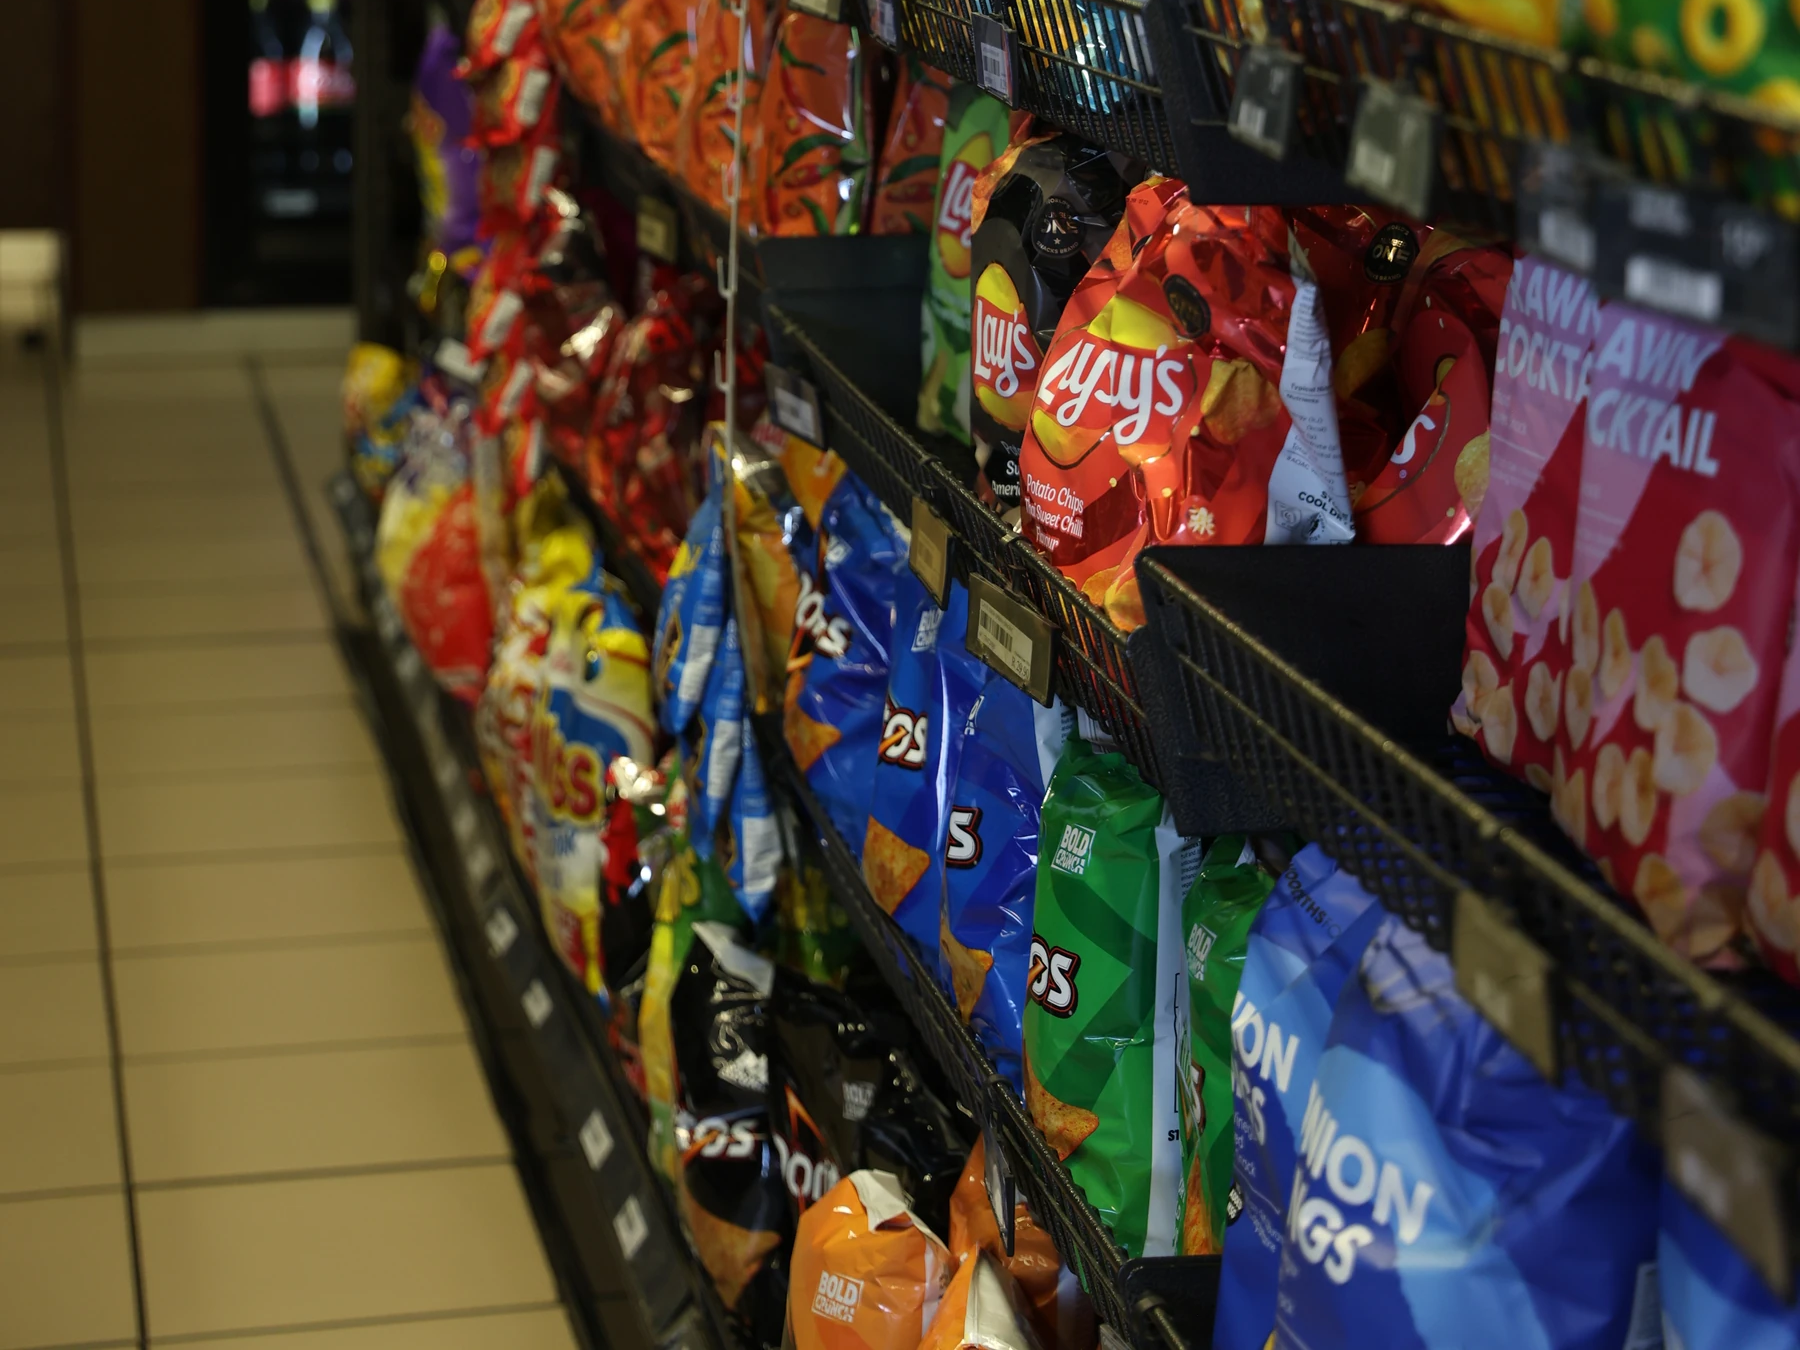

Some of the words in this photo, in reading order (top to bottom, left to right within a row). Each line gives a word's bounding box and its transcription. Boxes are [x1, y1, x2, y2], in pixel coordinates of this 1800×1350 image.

[974, 299, 1035, 397] Lay's
[1026, 473, 1057, 502] Potato
[1057, 487, 1084, 517] Chips
[1298, 491, 1327, 513] COOL
[1037, 504, 1061, 529] Sweet
[1060, 515, 1084, 539] Chilli
[1060, 824, 1088, 857] BOLD
[818, 1271, 859, 1307] BOLD
